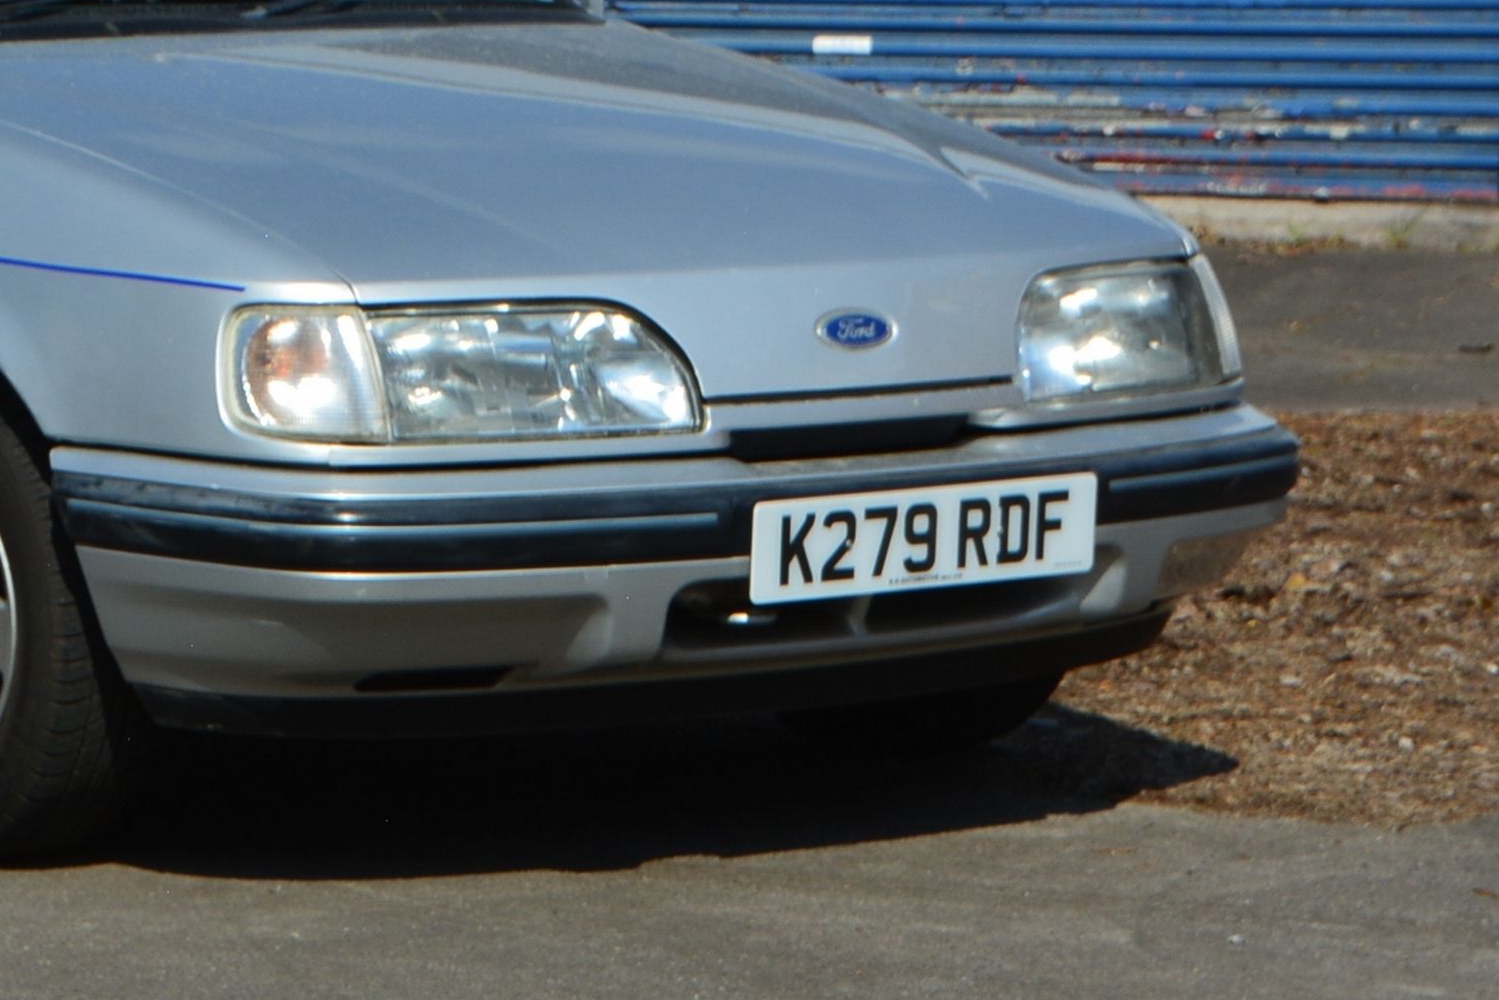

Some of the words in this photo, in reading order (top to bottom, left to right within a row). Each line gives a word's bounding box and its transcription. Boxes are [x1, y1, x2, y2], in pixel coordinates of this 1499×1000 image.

[837, 317, 876, 341] Ford
[779, 502, 938, 587] K279
[957, 488, 1070, 570] RDF
